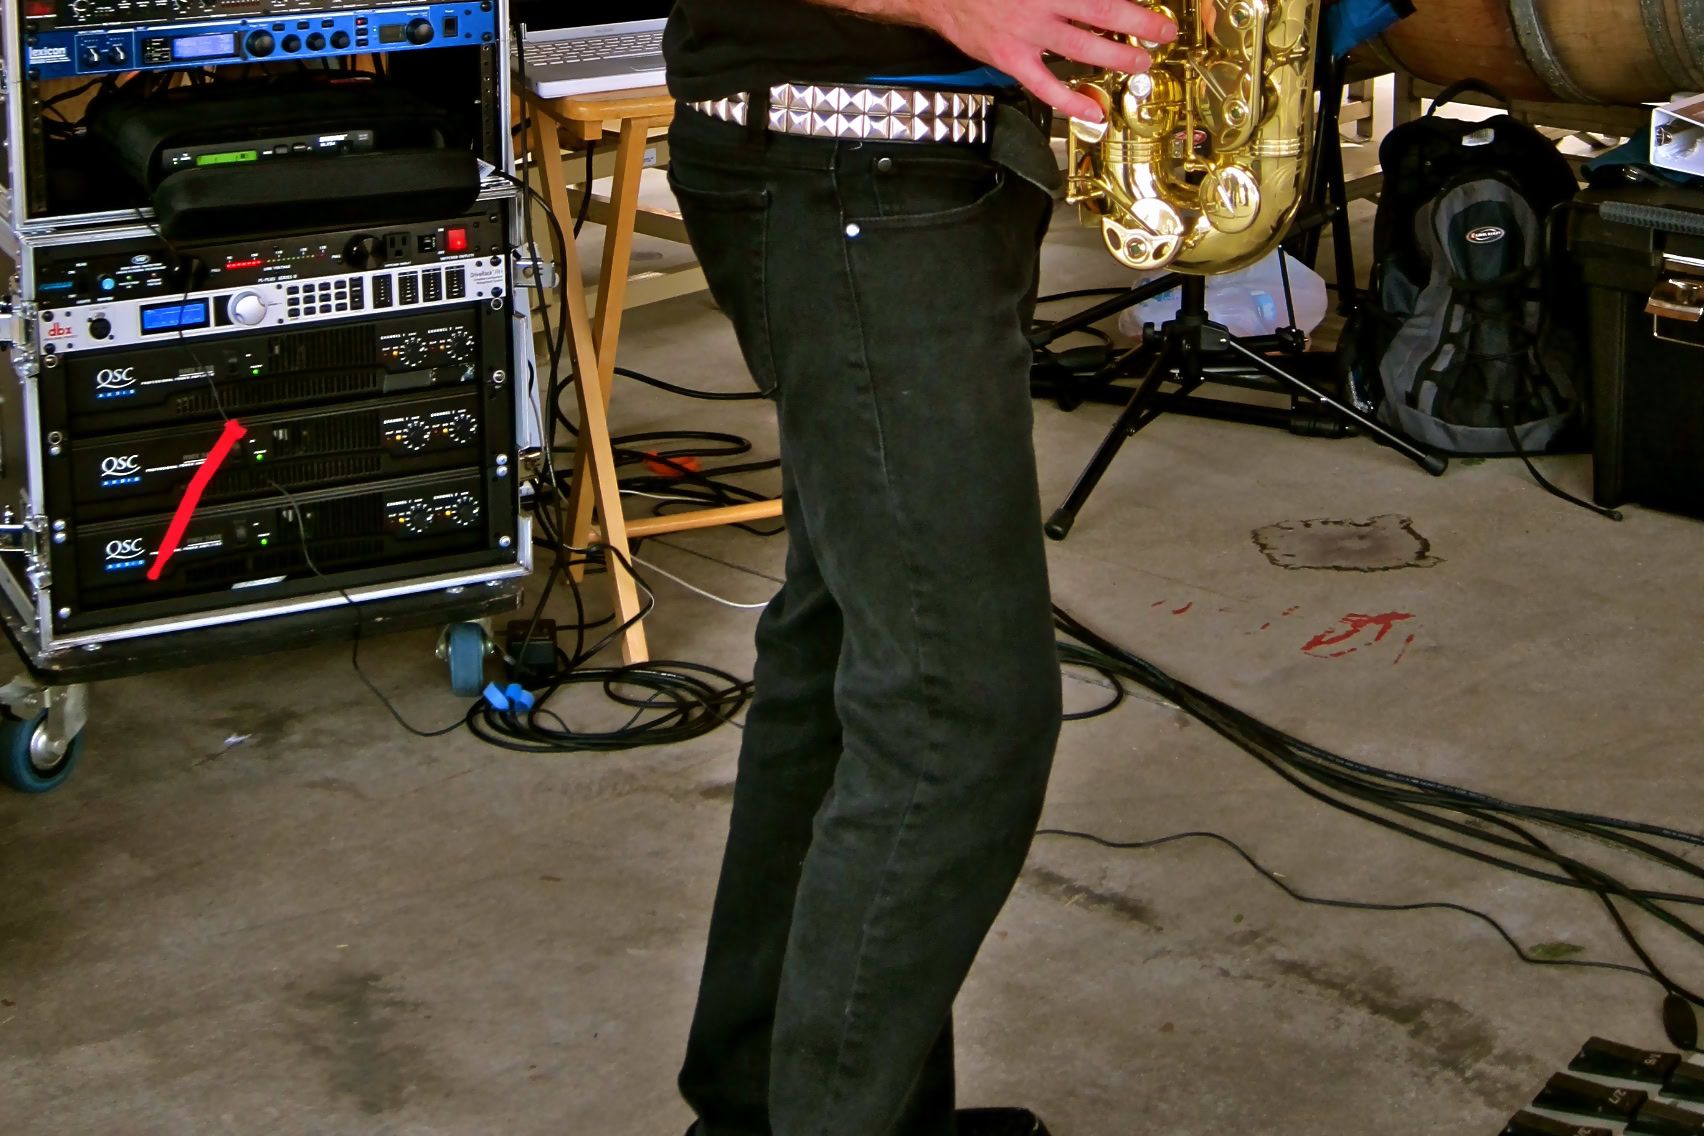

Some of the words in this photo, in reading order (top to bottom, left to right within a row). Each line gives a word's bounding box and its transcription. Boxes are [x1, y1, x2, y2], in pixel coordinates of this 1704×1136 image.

[28, 46, 67, 57] lexicon
[48, 322, 72, 336] dbx
[96, 367, 137, 389] QSC
[101, 454, 141, 477] QSC
[105, 538, 145, 560] QSC
